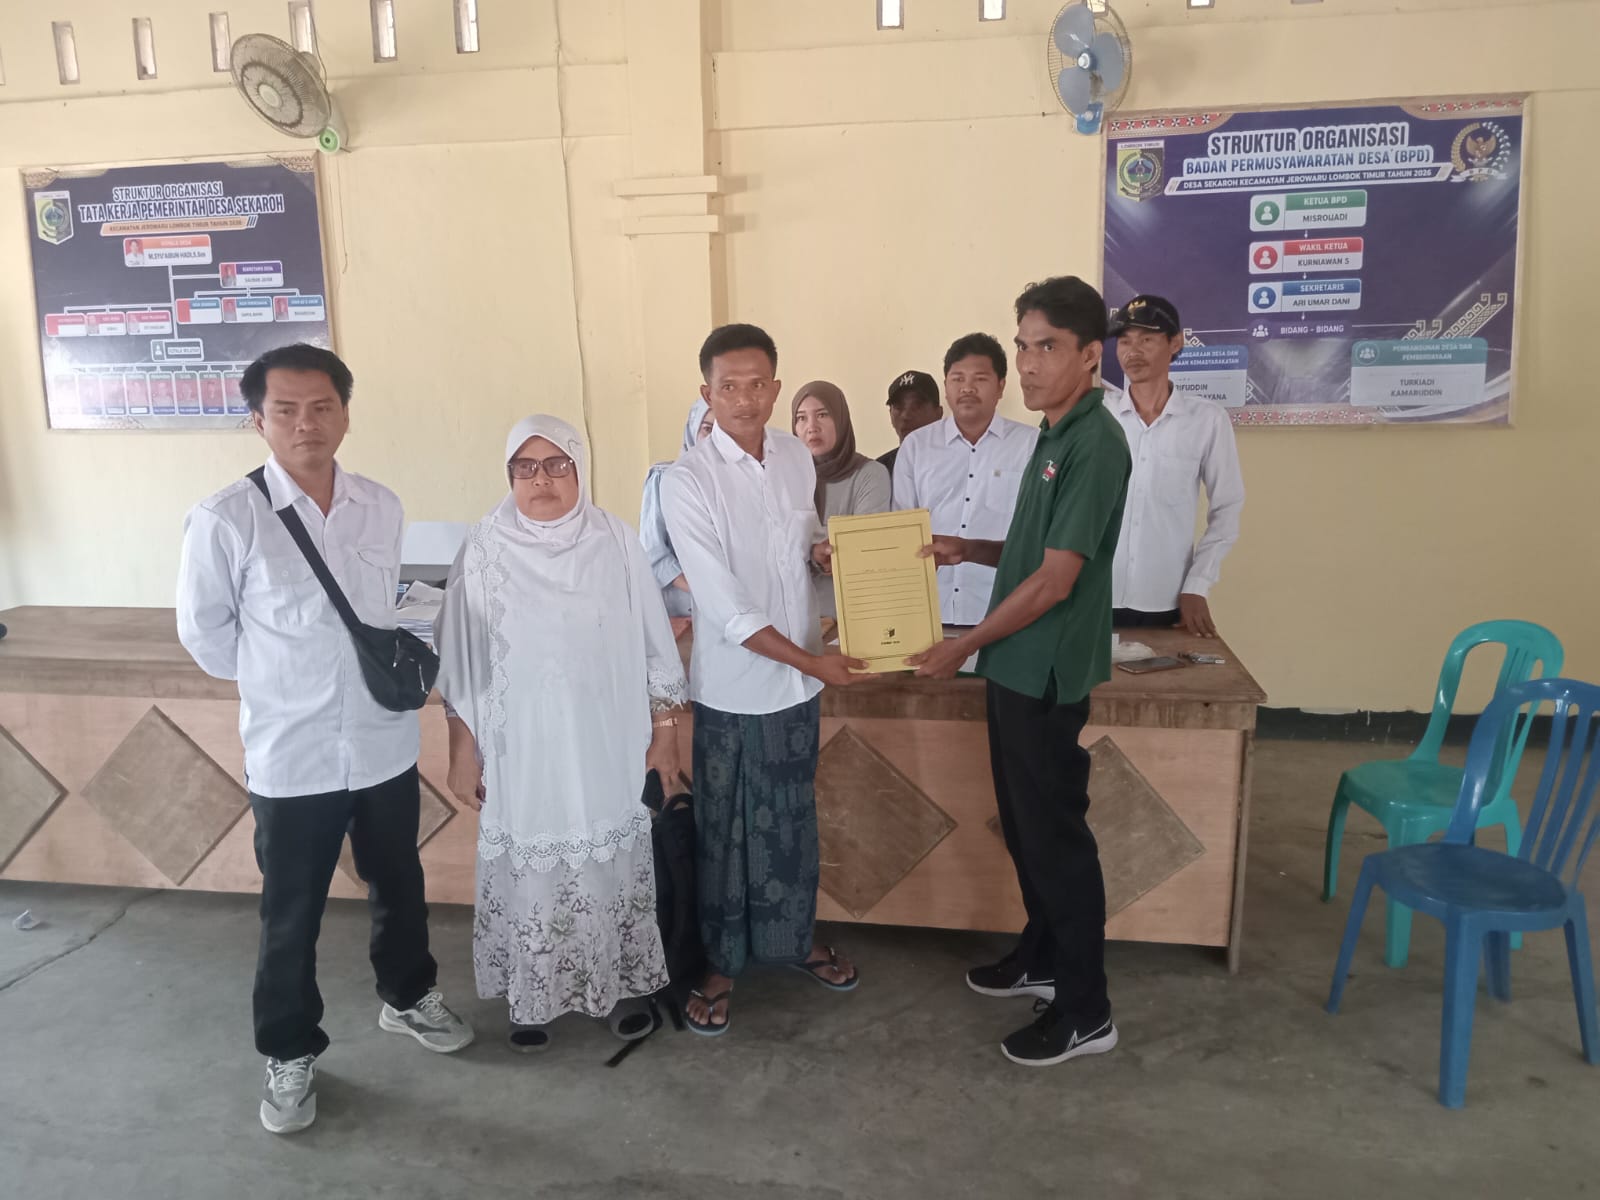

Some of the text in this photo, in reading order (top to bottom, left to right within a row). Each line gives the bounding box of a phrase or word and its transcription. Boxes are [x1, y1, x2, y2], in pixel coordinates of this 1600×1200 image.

[1211, 126, 1405, 155] STRUKTUR ORGANISASI
[1186, 149, 1430, 174] BADAN PERMUSYAWARATAN DESA (BPD)
[1183, 181, 1202, 189] DESA
[1204, 179, 1238, 188] SEKAROH
[1240, 177, 1284, 186] KECAMATAN
[1287, 174, 1328, 183] JEROWARU
[1329, 172, 1361, 181] LOMBOK
[1363, 171, 1385, 179] TIMUR
[1388, 170, 1412, 178] TAHUN
[113, 182, 222, 200] STRUKTUR ORGANISASI
[1303, 196, 1348, 205] KETUA BPD
[79, 195, 284, 221] TATA KERJA PEMERINTAH DESA SEKAROH
[1299, 242, 1348, 251] WAKIL KETUA
[1297, 257, 1350, 266] KURNIAWAN S
[1300, 283, 1344, 292] SEKRETARIS
[1308, 298, 1330, 306] UMAR
[1280, 326, 1308, 334] BIDANG
[1316, 325, 1344, 333] BIDANG
